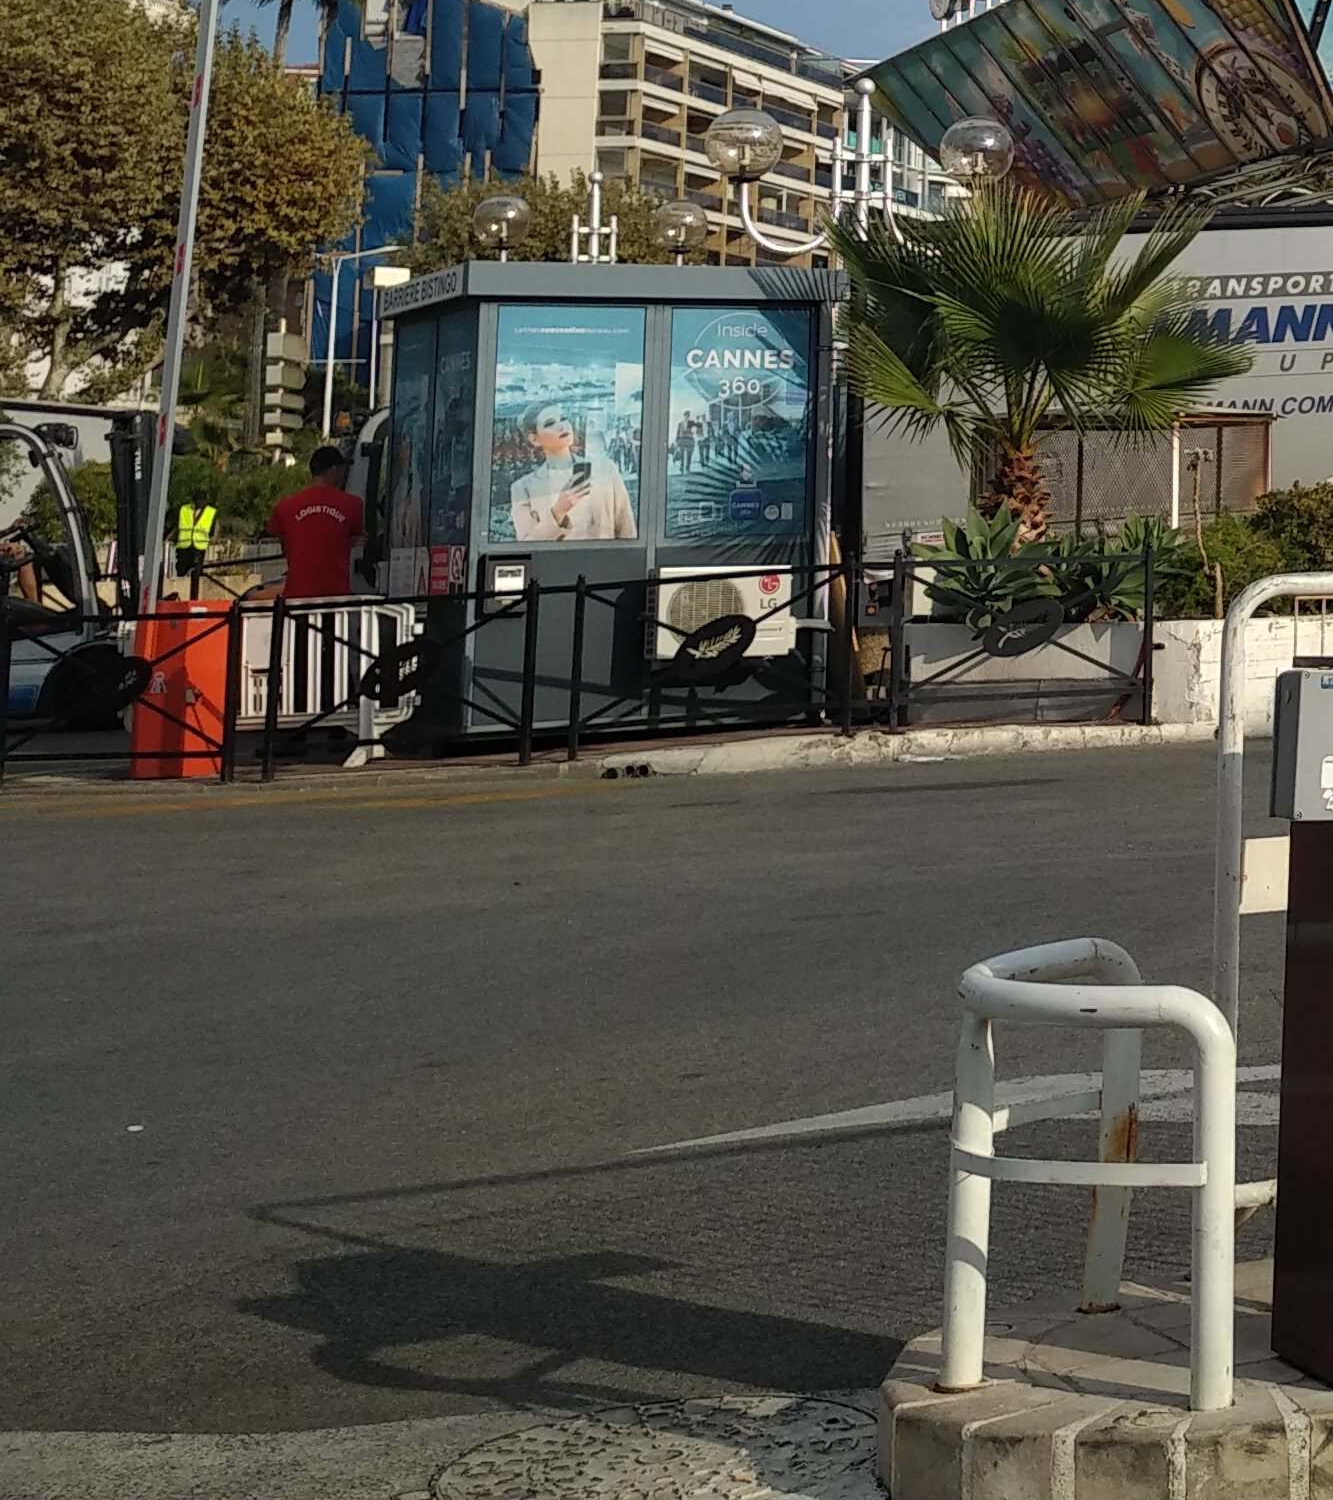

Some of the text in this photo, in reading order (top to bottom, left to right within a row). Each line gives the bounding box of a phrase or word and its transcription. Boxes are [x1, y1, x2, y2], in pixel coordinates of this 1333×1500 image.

[421, 271, 457, 301] BISTINGO
[717, 322, 768, 338] Inside
[686, 348, 794, 370] CANNES
[718, 376, 760, 399] 360
[294, 505, 346, 523] LOGISTIQUE
[759, 598, 778, 610] LG
